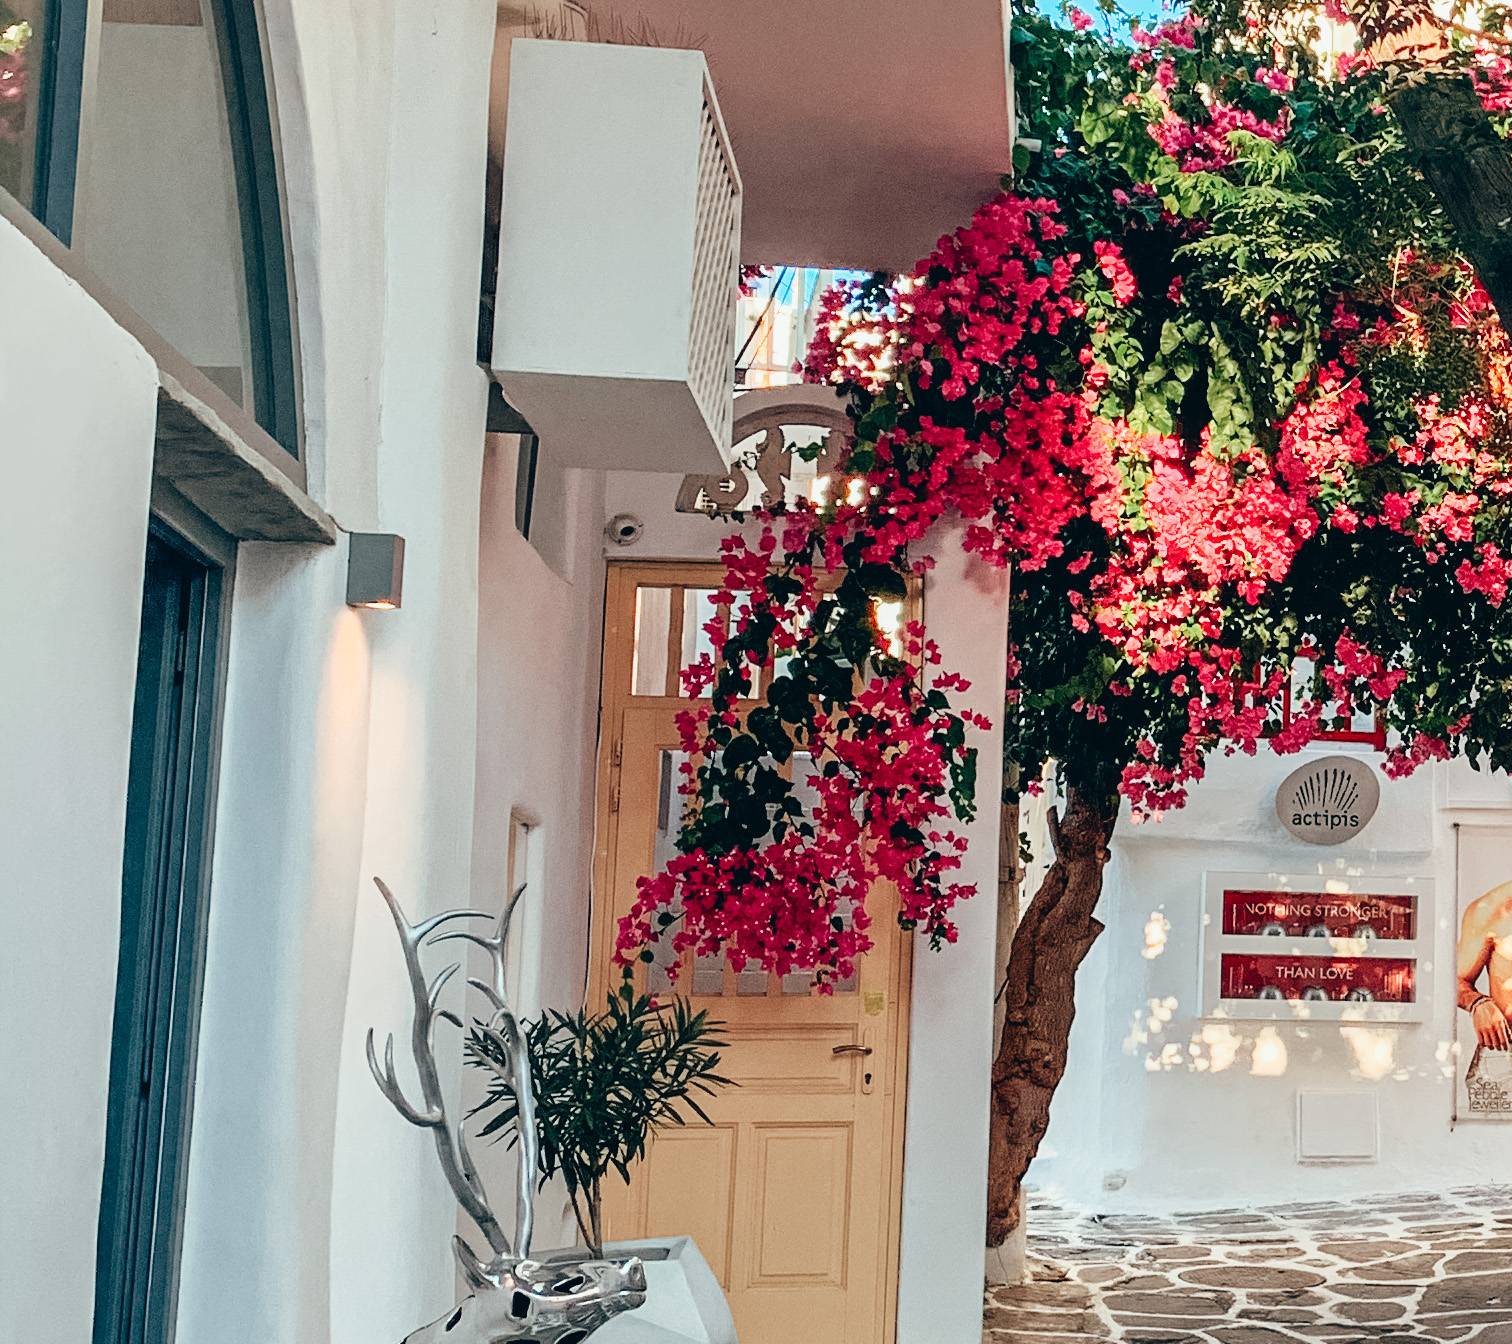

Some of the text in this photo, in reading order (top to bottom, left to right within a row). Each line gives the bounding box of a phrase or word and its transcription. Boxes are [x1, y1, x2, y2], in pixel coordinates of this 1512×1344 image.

[1292, 809, 1360, 830] actipis
[1245, 902, 1388, 919] NOTHING STRONGER
[1276, 966, 1354, 980] THAN LOVE
[1476, 1076, 1498, 1089] Sea
